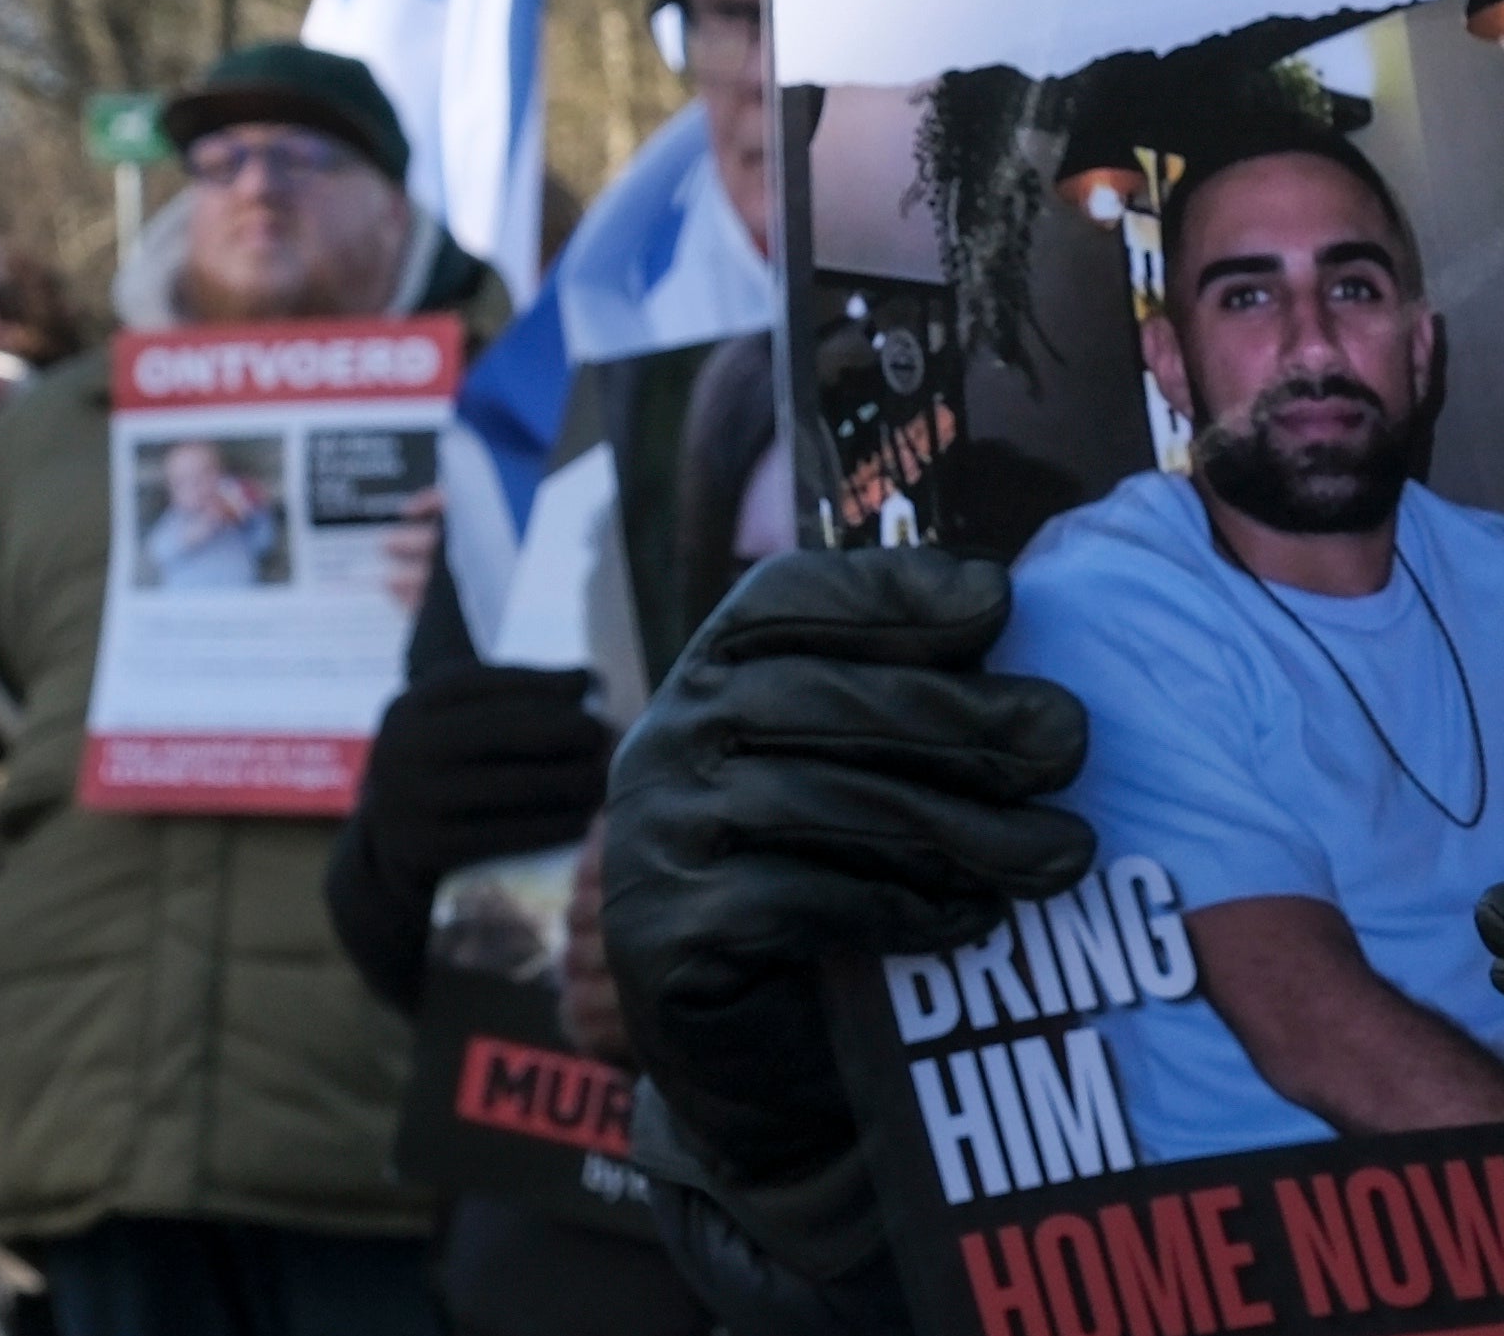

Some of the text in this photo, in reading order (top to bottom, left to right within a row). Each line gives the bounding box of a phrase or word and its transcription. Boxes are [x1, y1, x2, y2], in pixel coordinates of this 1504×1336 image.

[133, 334, 443, 399] ONTVOERD
[881, 853, 1198, 1046] BRING
[909, 1025, 1136, 1206] HIM
